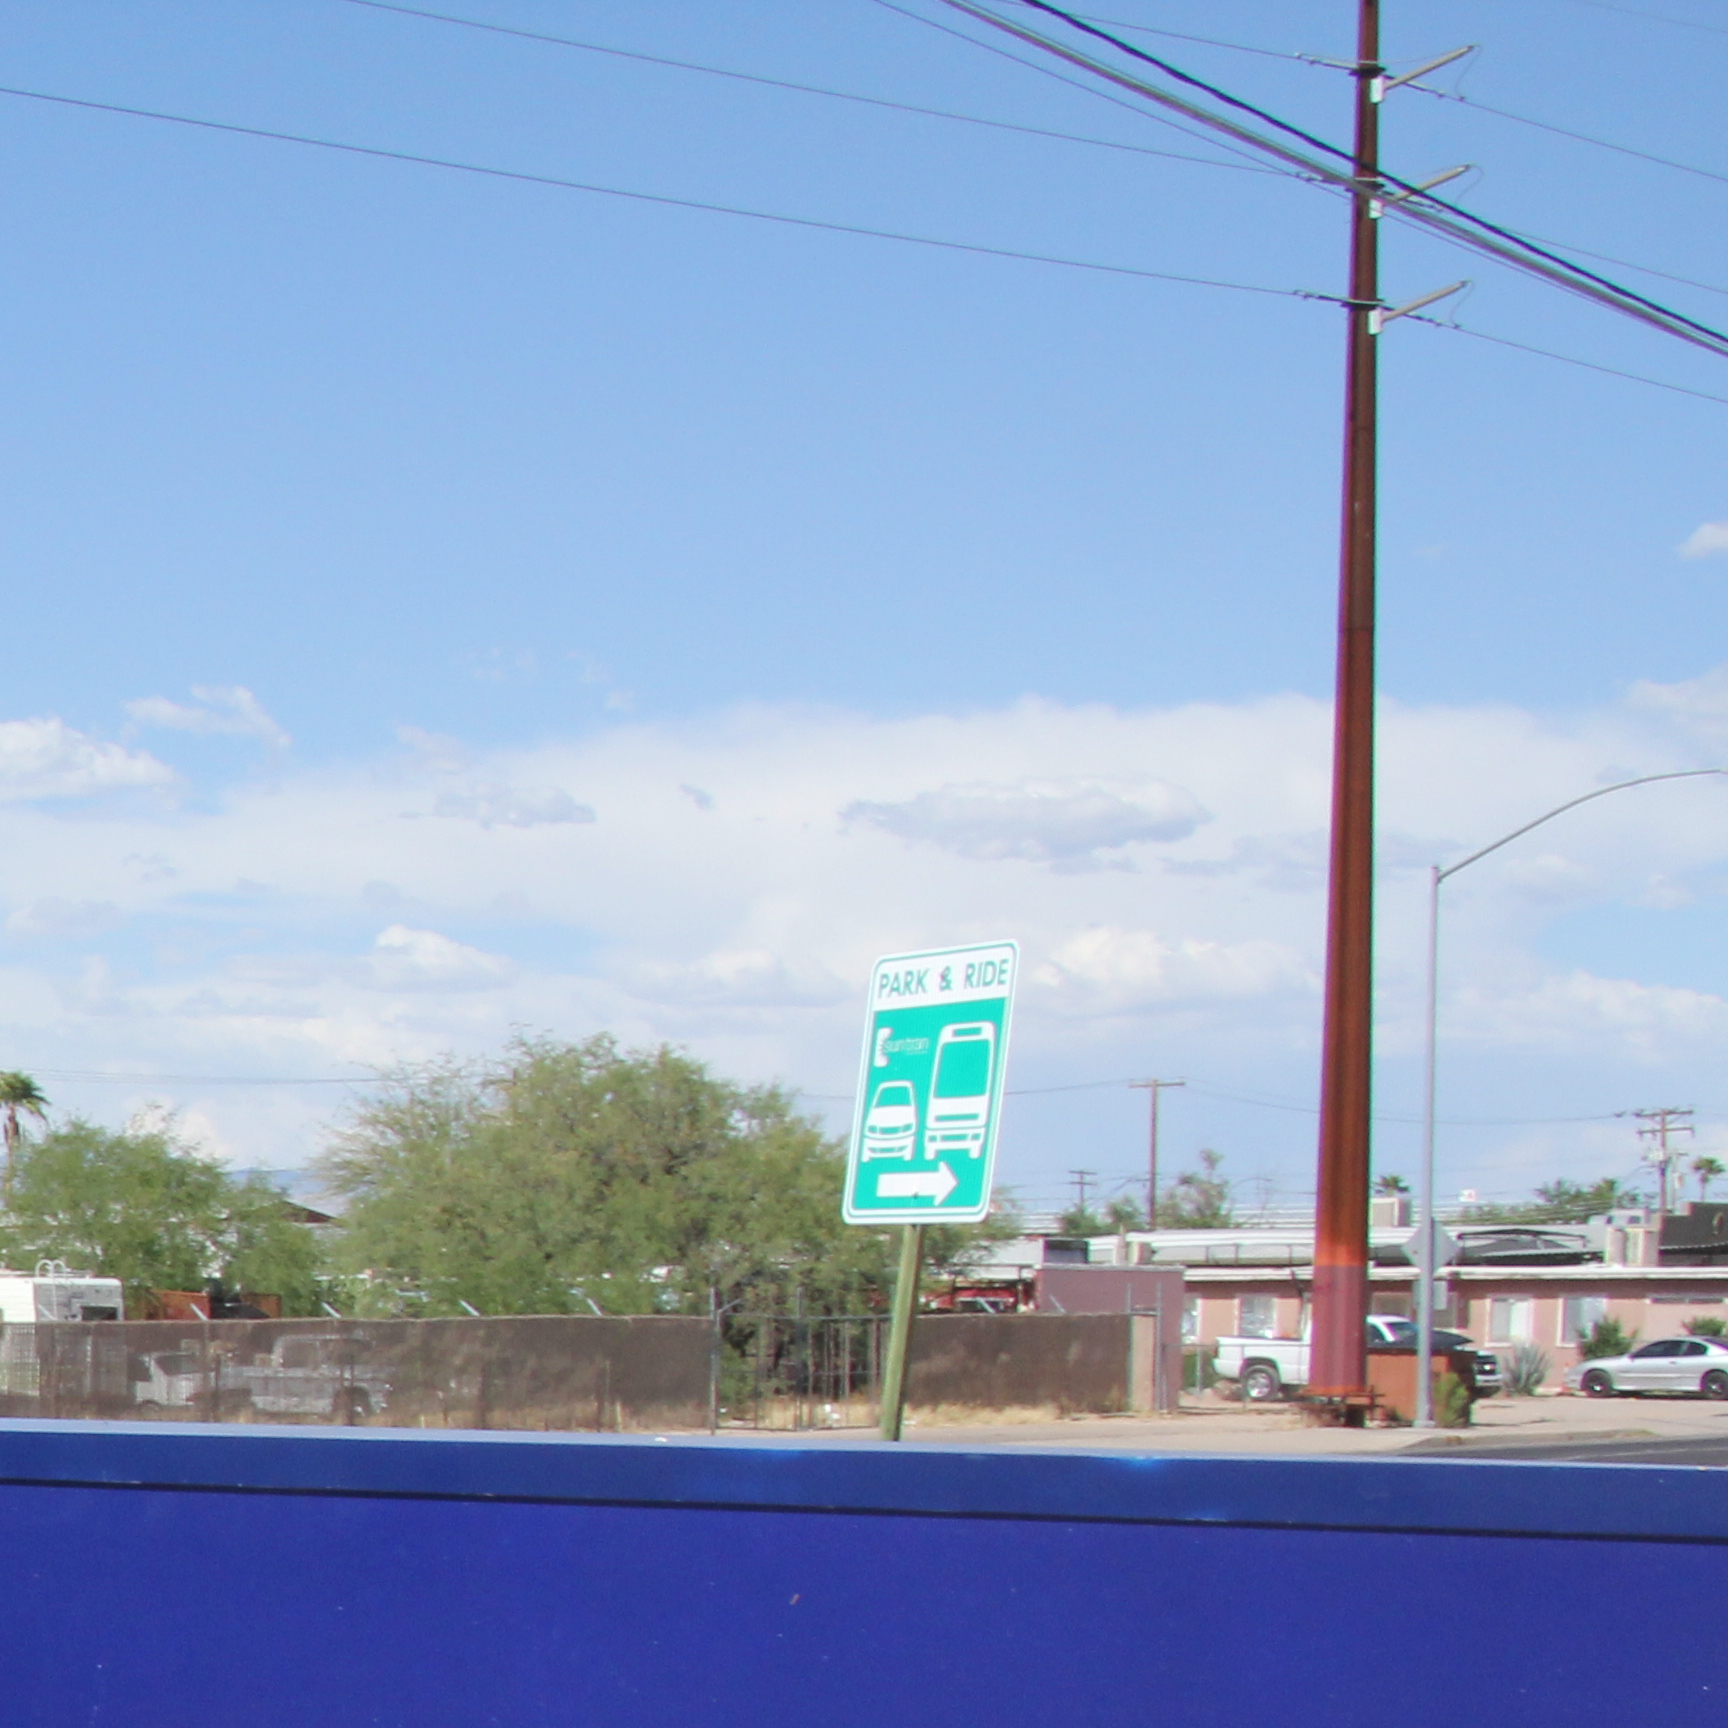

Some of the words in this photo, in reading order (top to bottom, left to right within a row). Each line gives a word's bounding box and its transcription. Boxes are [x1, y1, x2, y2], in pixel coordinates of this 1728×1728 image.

[878, 968, 929, 998] PARK
[939, 965, 952, 991] &
[964, 958, 1009, 989] RIDE
